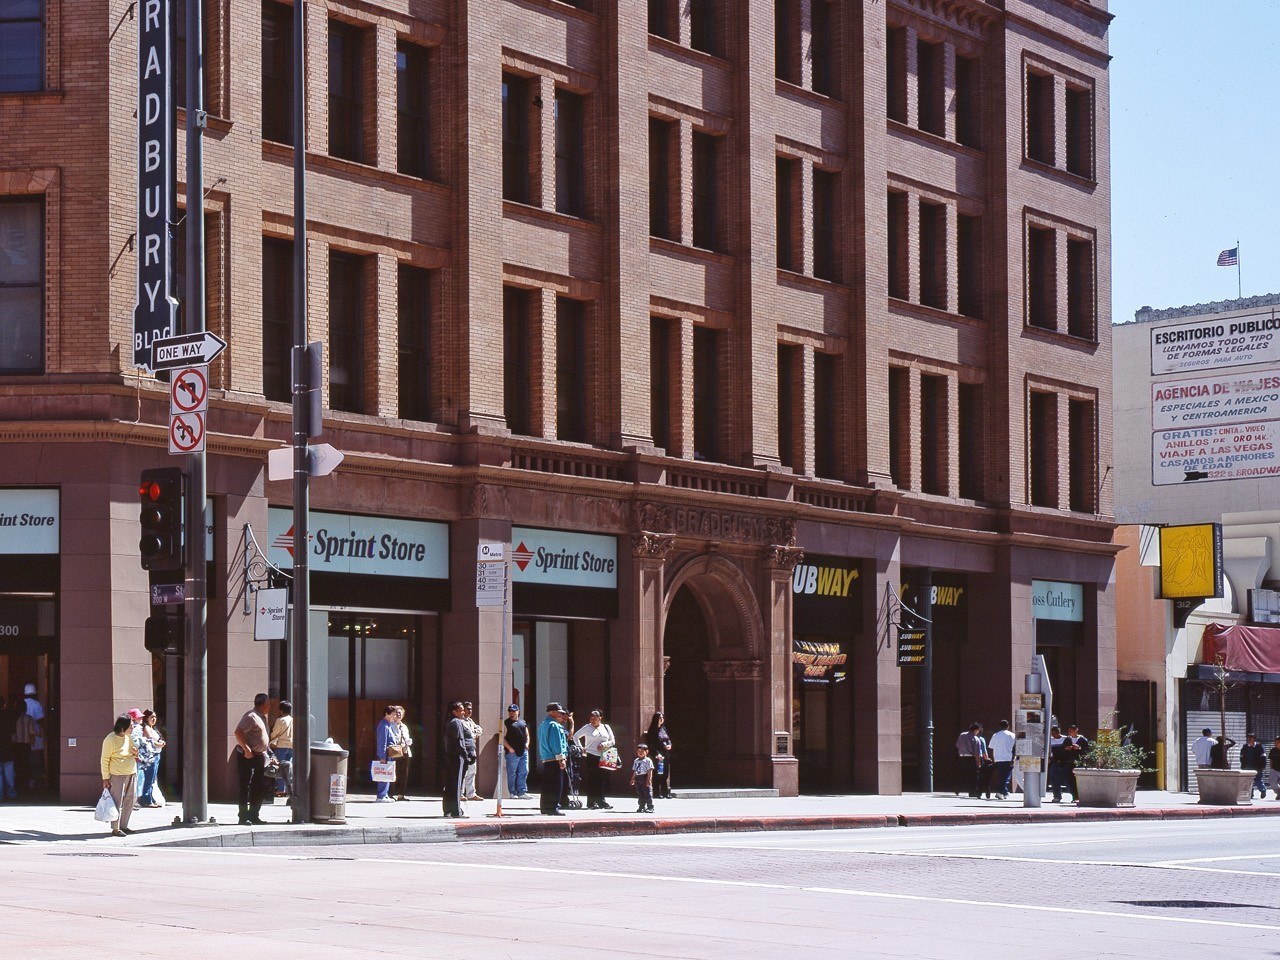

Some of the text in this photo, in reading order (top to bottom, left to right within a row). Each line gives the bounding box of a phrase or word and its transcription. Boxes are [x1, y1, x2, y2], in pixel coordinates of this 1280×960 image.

[134, 326, 170, 351] BLDG
[1155, 318, 1280, 345] ESCRITORIO PUBLICO
[159, 343, 203, 360] ONE WAY
[1163, 333, 1273, 353] LLENAMOS TODO TIPO
[1182, 347, 1222, 359] FORMAS
[1225, 342, 1269, 353] LEGALES
[1179, 359, 1210, 368] SEGUROS
[1155, 384, 1210, 402] AGENCIA
[1213, 383, 1230, 395] DE
[1160, 400, 1220, 413] ESPECIALES
[1234, 394, 1279, 405] MEXICO
[1182, 406, 1268, 421] CENTROAMERICA
[1162, 428, 1218, 441] GRATIS:
[1219, 427, 1239, 435] CINTA
[1244, 425, 1265, 433] VIDEO
[1165, 438, 1209, 449] ANILLOS
[1233, 434, 1252, 443] ORO
[1160, 442, 1273, 459] VIAJE A LAS VEGAS
[1160, 456, 1215, 468] CASAMOS
[1225, 452, 1275, 461] MENORES
[1202, 462, 1233, 470] EDAD
[1208, 470, 1227, 478] 322
[1236, 466, 1280, 476] BROADWA
[20, 513, 54, 526] Store
[313, 529, 425, 563] Sprint Store
[535, 545, 615, 573] Sprint Store
[793, 564, 859, 597] UBWAY
[931, 585, 964, 606] BWAY
[1032, 590, 1076, 613] oss Cutlery
[267, 607, 283, 616] Sprint
